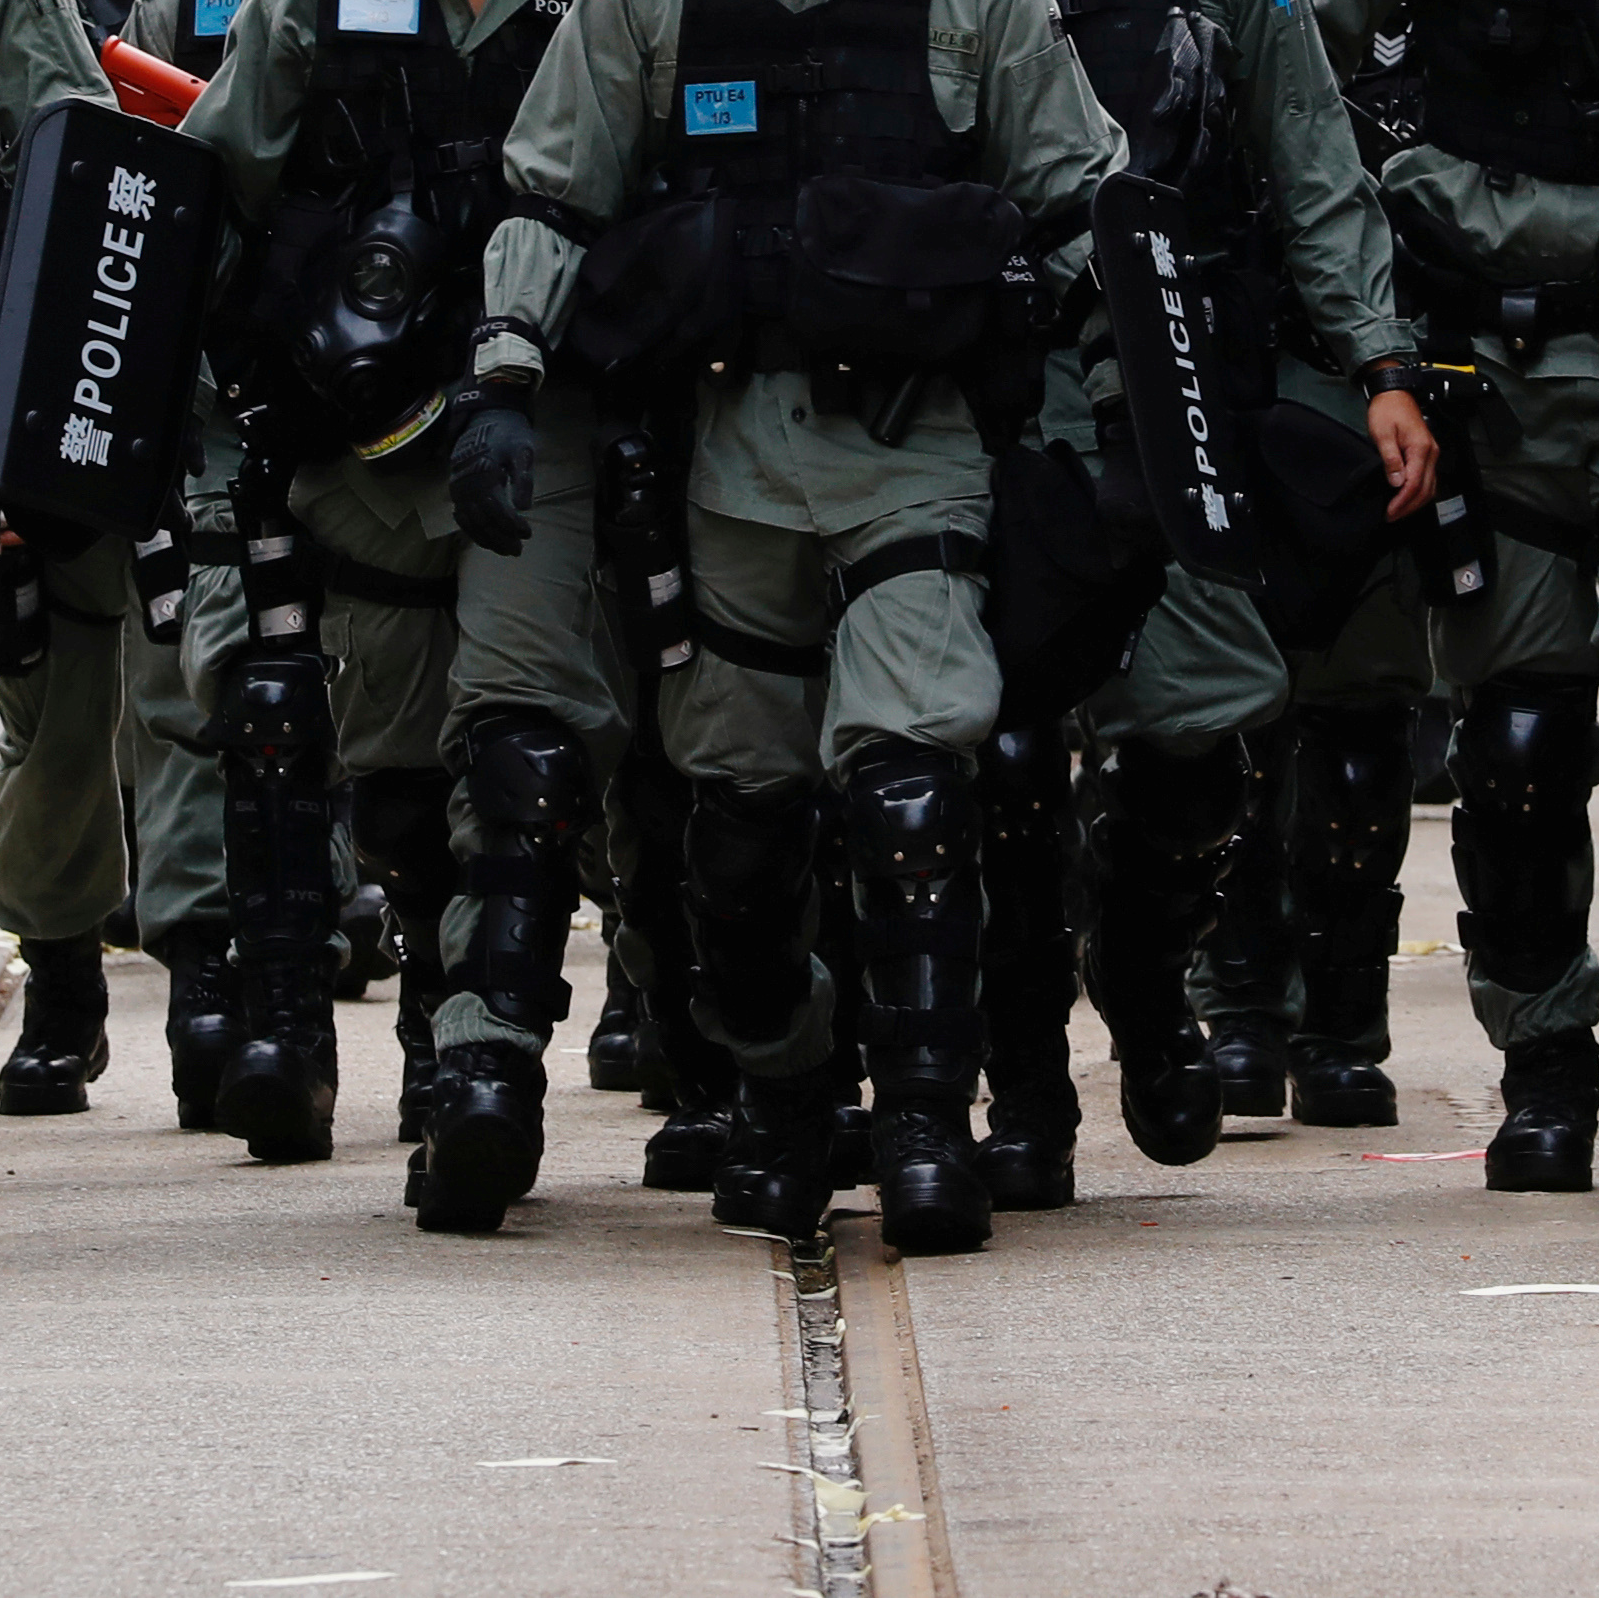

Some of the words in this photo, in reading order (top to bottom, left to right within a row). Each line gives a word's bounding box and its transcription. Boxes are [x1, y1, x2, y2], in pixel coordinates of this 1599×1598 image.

[695, 90, 723, 103] PTU
[728, 89, 746, 102] E4
[711, 111, 731, 124] 1/3
[73, 222, 145, 415] POLICE
[1160, 288, 1218, 477] POLICE
